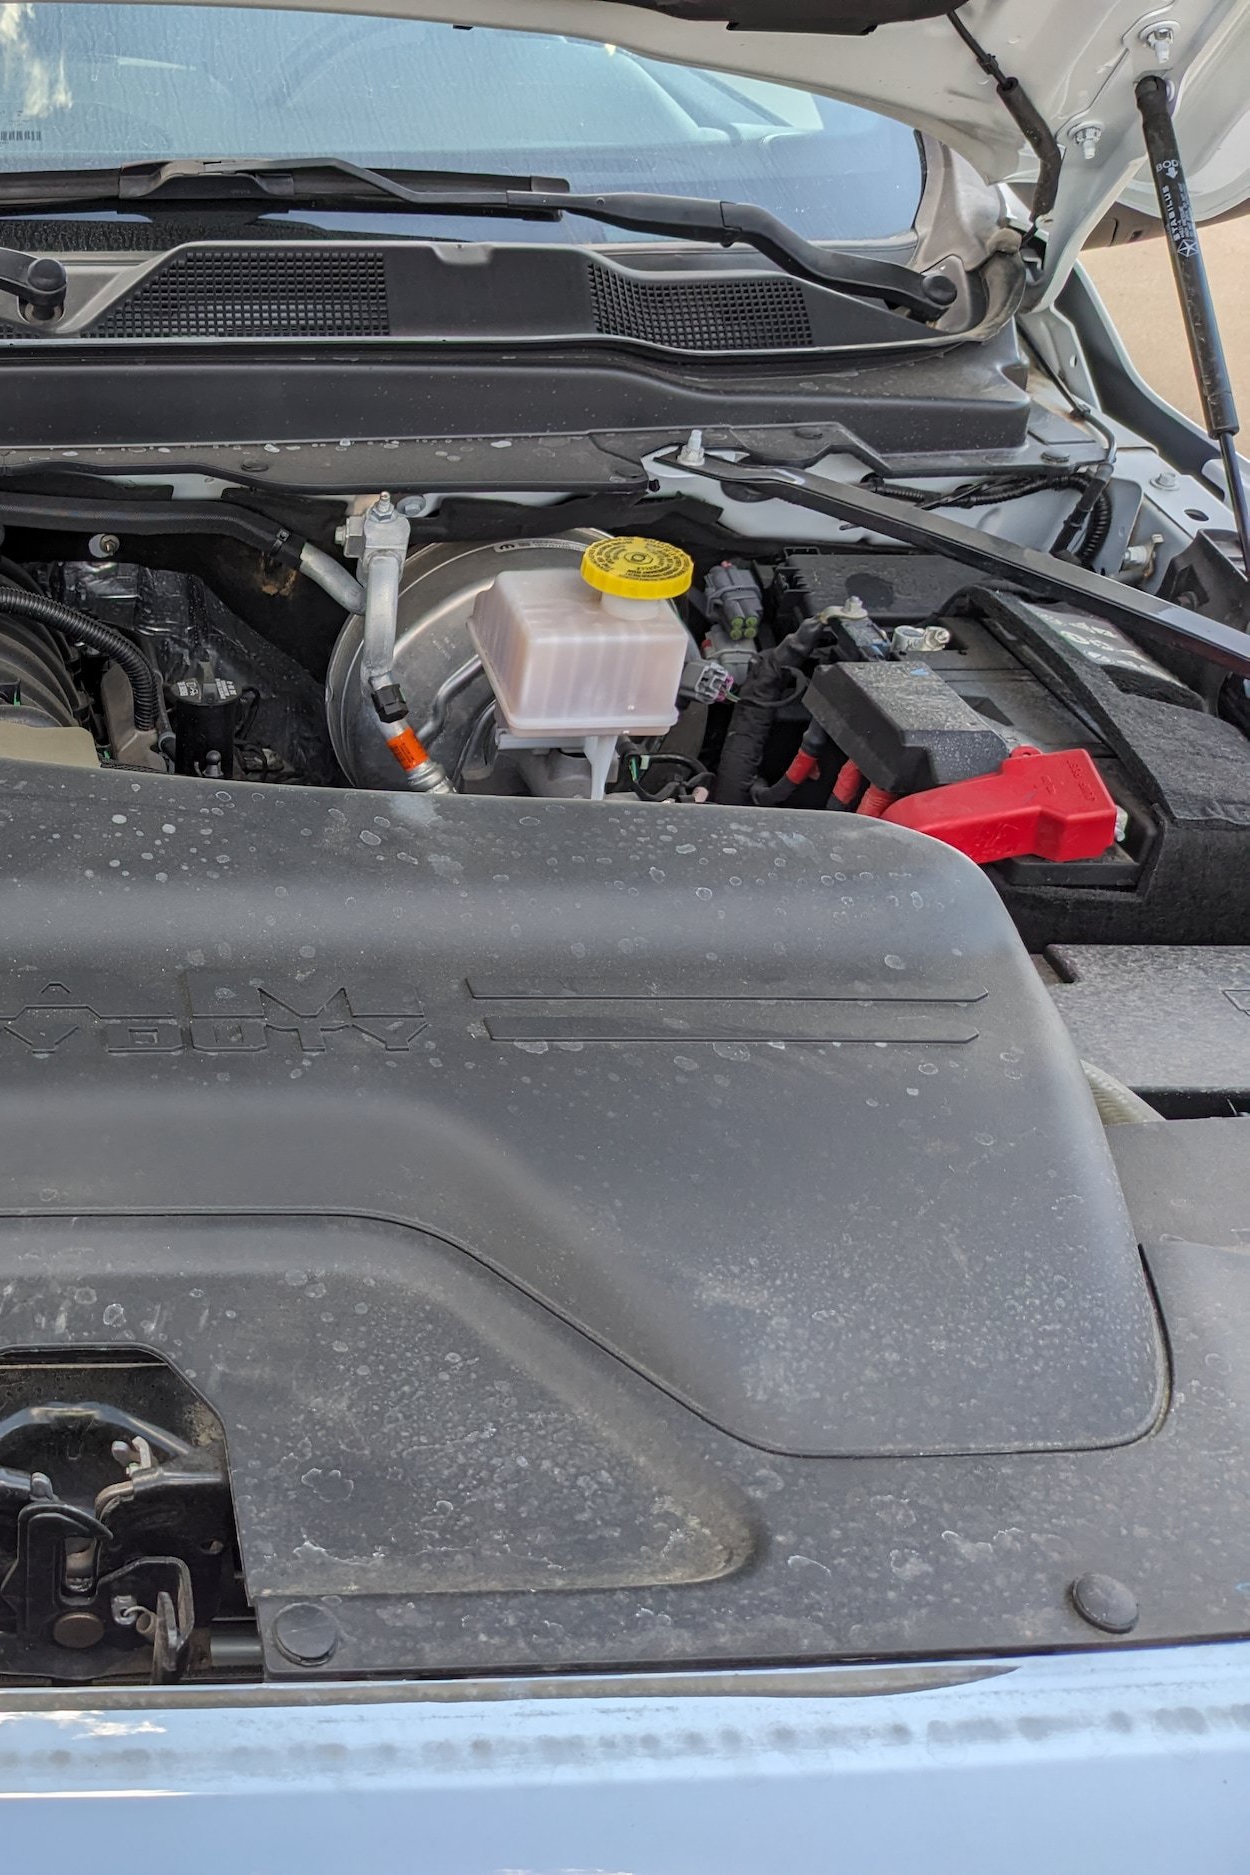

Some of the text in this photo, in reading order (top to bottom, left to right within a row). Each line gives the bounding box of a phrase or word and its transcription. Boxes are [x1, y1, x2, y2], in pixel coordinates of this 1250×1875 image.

[1156, 159, 1179, 172] BOD
[1163, 185, 1181, 240] STABILUS
[102, 1018, 431, 1053] DUTY
